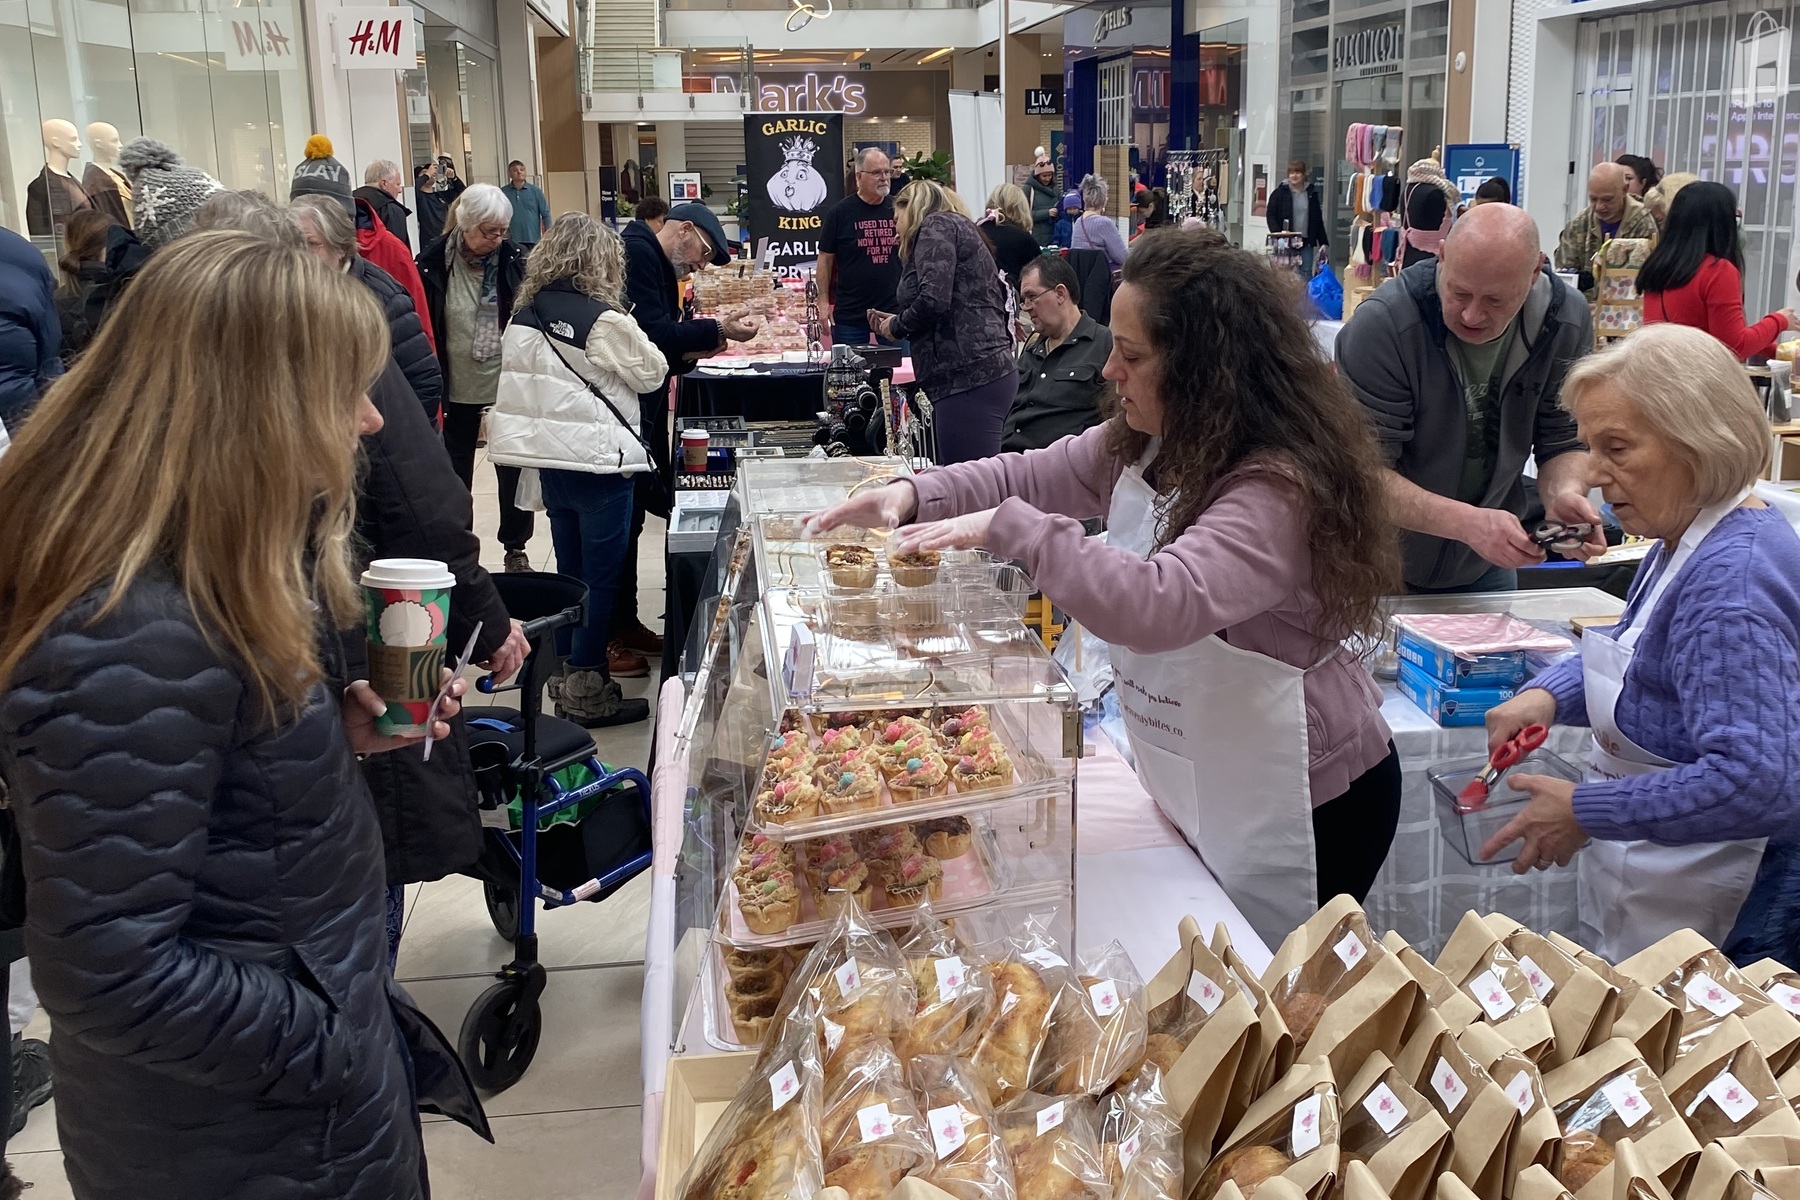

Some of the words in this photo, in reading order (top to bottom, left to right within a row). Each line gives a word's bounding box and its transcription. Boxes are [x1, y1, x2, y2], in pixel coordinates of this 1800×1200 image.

[348, 19, 402, 56] H&M
[1031, 90, 1053, 106] Liv
[762, 118, 827, 136] GARLIC
[294, 164, 341, 183] SLAY
[778, 215, 822, 230] KING
[858, 220, 877, 229] USED
[878, 219, 889, 228] TO
[864, 228, 893, 238] RETIRED
[768, 240, 820, 256] GARLI
[857, 238, 874, 247] NOW
[866, 246, 880, 256] FOR
[882, 245, 893, 255] MY
[871, 254, 889, 264] WIFE
[1499, 690, 1514, 699] 100
[579, 783, 600, 798] nexus
